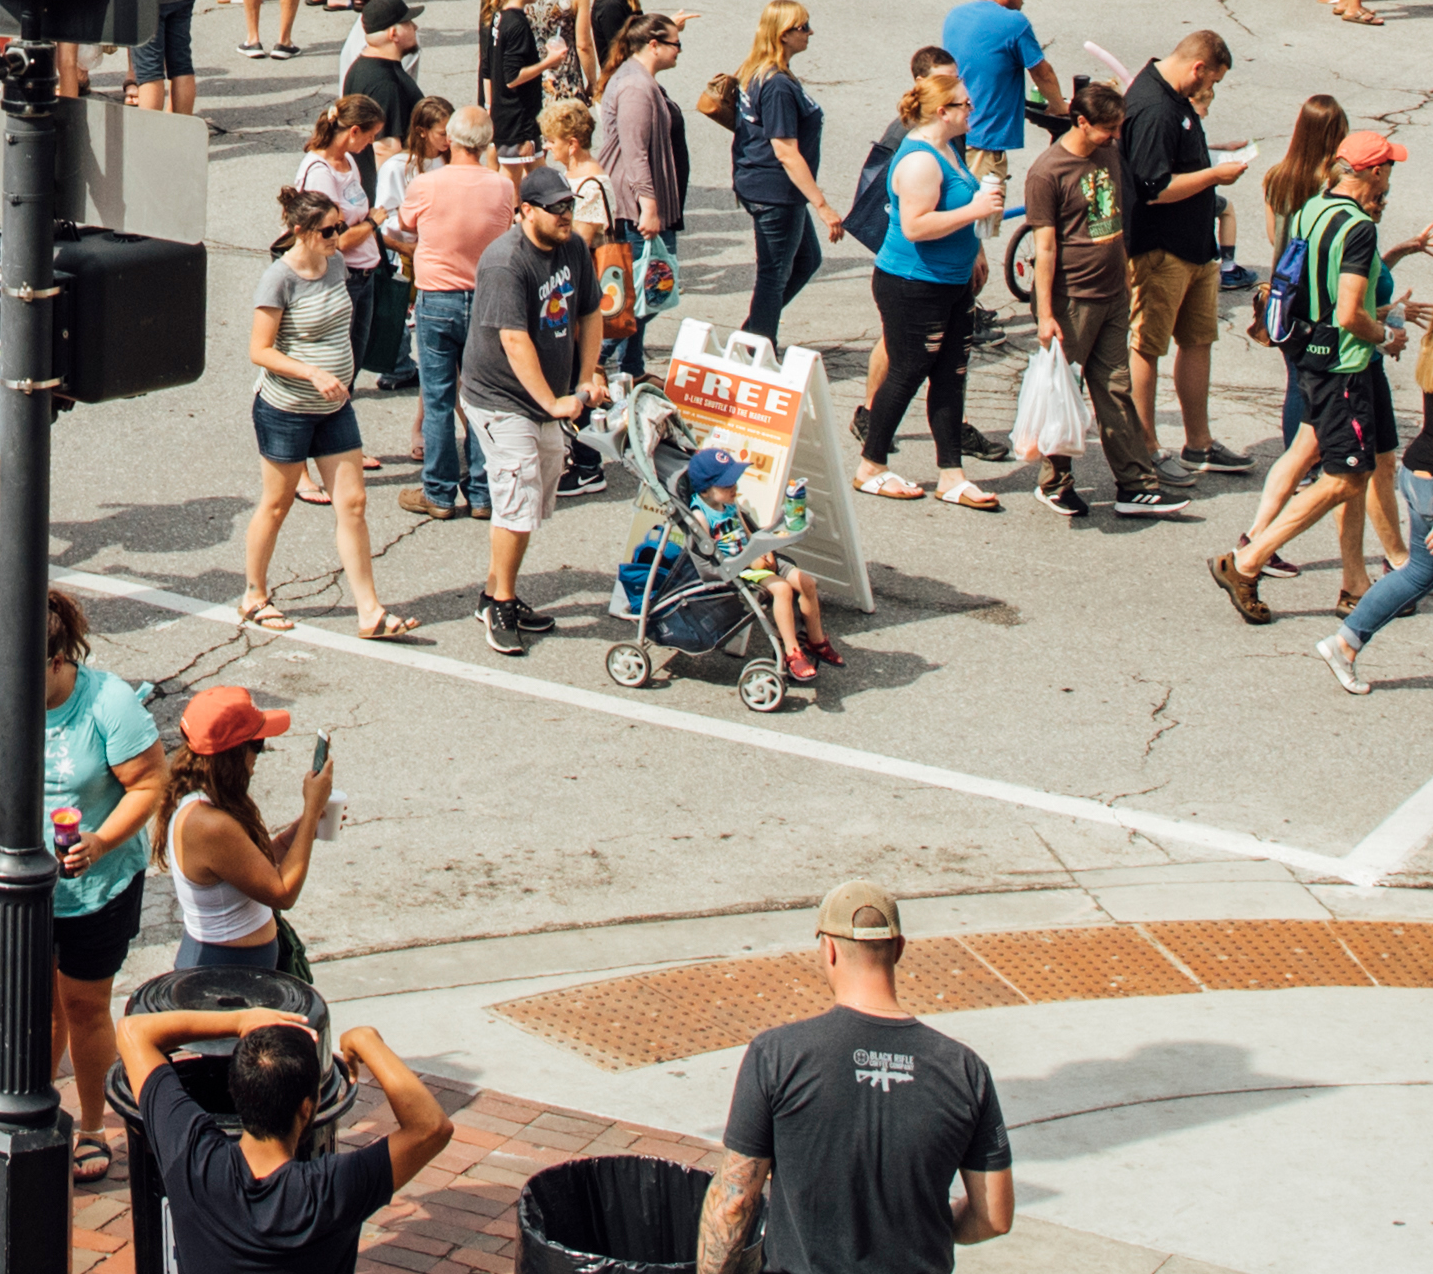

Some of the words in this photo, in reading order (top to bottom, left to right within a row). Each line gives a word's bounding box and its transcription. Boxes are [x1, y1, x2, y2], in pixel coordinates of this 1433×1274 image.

[674, 364, 792, 416] FREE
[684, 393, 703, 405] D-LINE
[704, 398, 728, 412] SHUTTLE
[728, 406, 737, 414] TO
[737, 408, 748, 418] THE
[748, 411, 772, 424] MARKET
